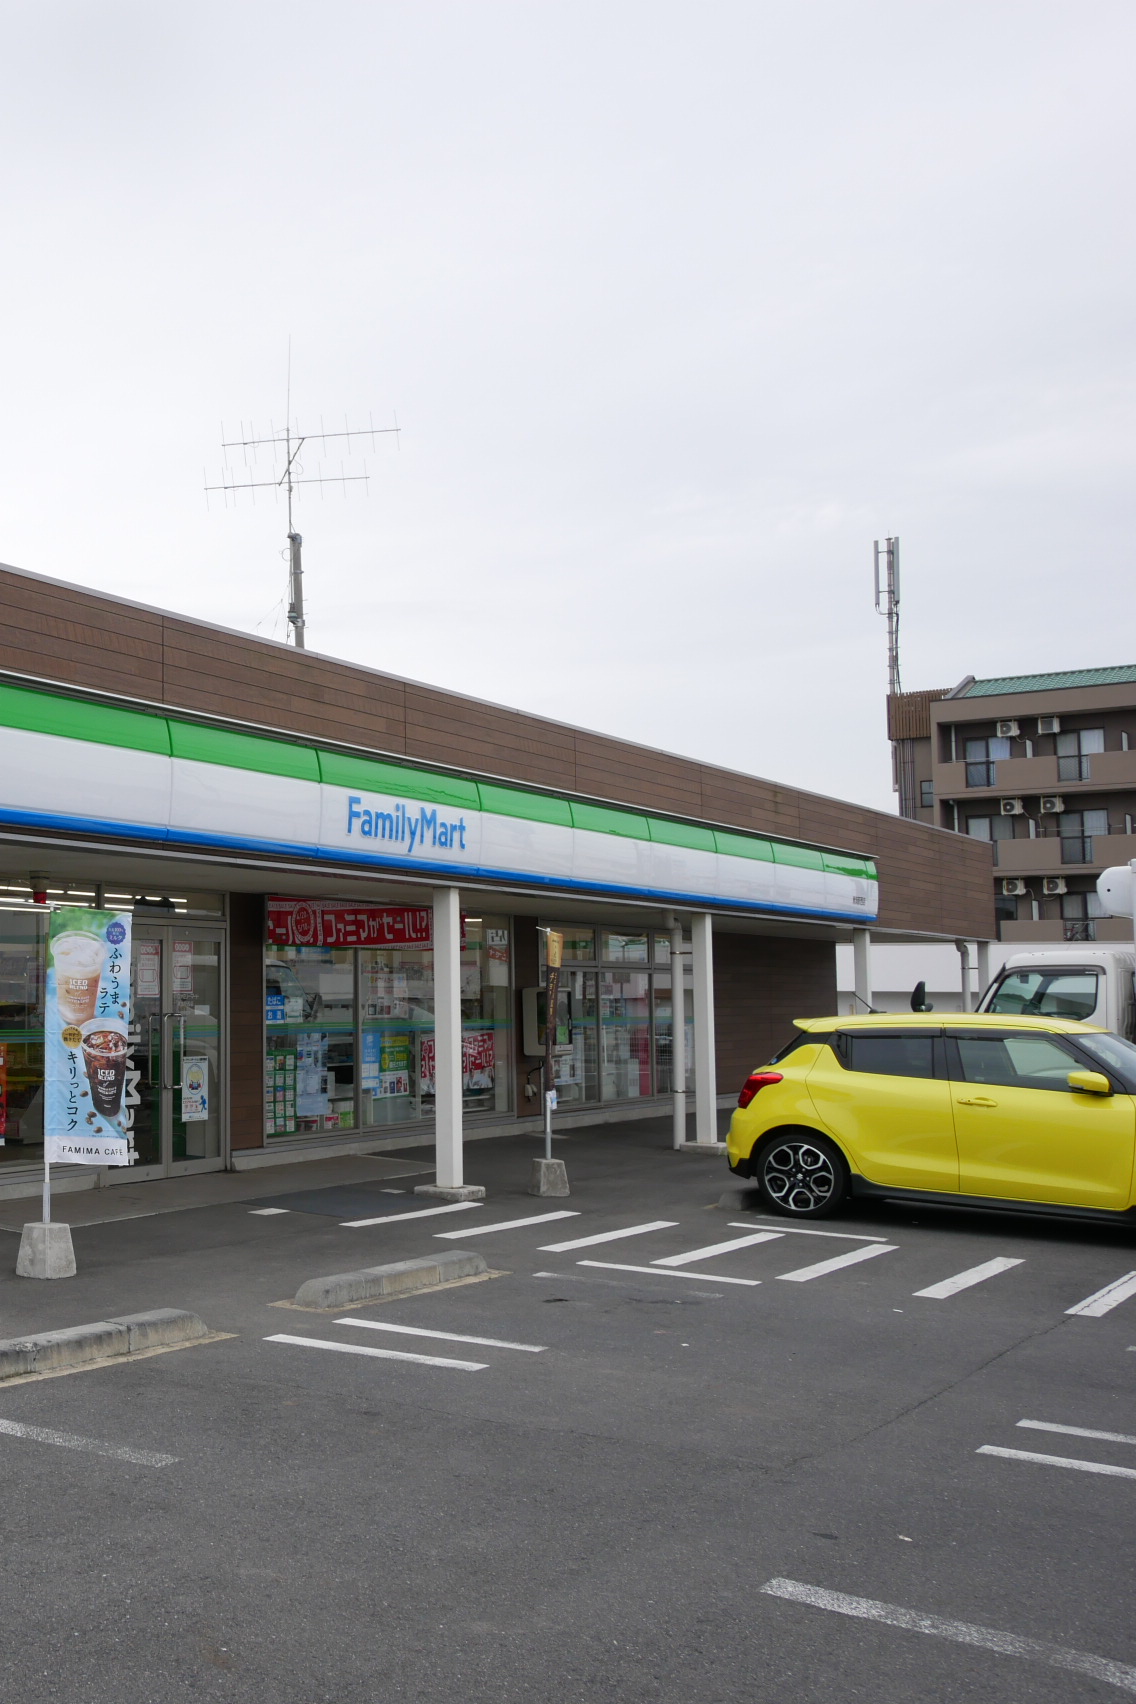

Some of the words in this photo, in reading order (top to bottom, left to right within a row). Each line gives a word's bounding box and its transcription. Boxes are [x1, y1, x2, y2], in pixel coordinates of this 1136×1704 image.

[347, 796, 466, 853] FamilyMart
[99, 988, 110, 1014] ラテ
[109, 948, 122, 1005] ふわうま
[67, 1051, 80, 1132] キリっとコク
[62, 1145, 100, 1155] FAMIMA
